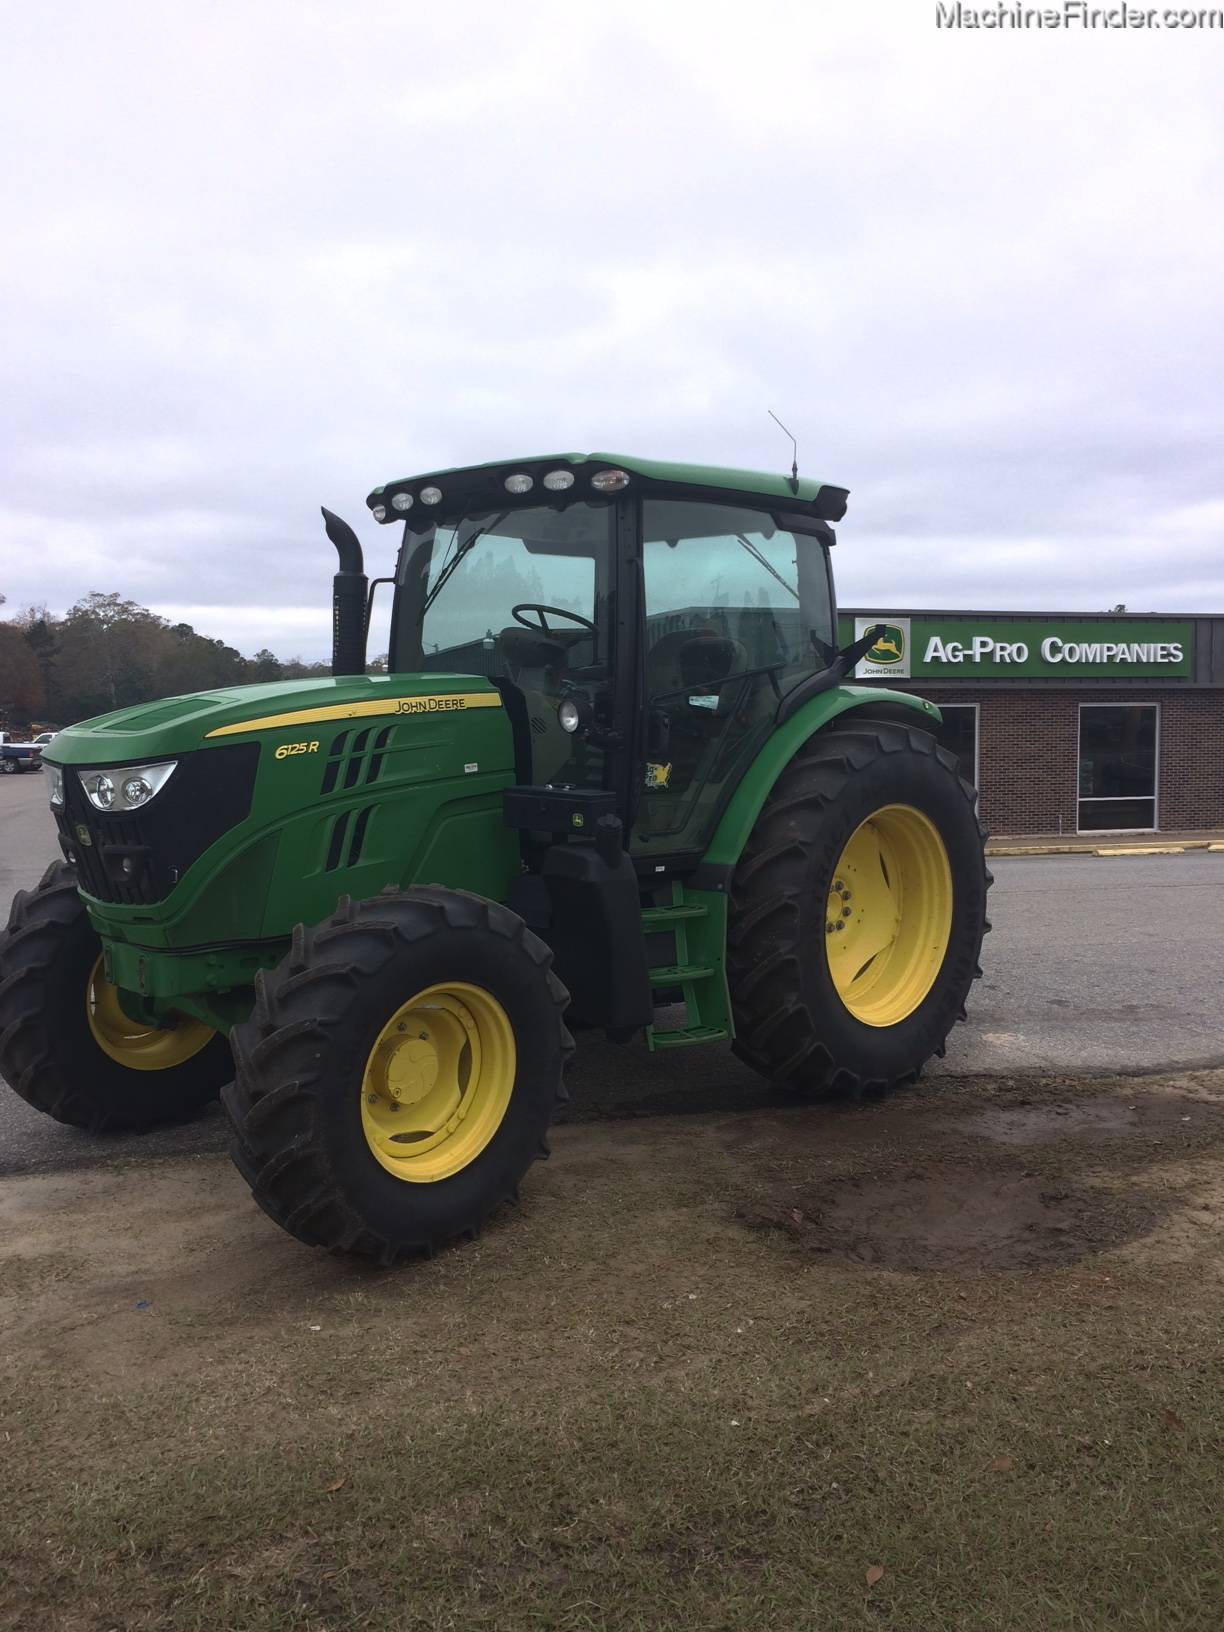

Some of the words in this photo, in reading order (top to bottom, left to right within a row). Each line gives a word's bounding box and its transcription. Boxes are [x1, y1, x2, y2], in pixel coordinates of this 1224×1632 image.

[883, 667, 905, 675] DEERE
[395, 701, 427, 713] JOHN
[428, 698, 466, 710] DEERE
